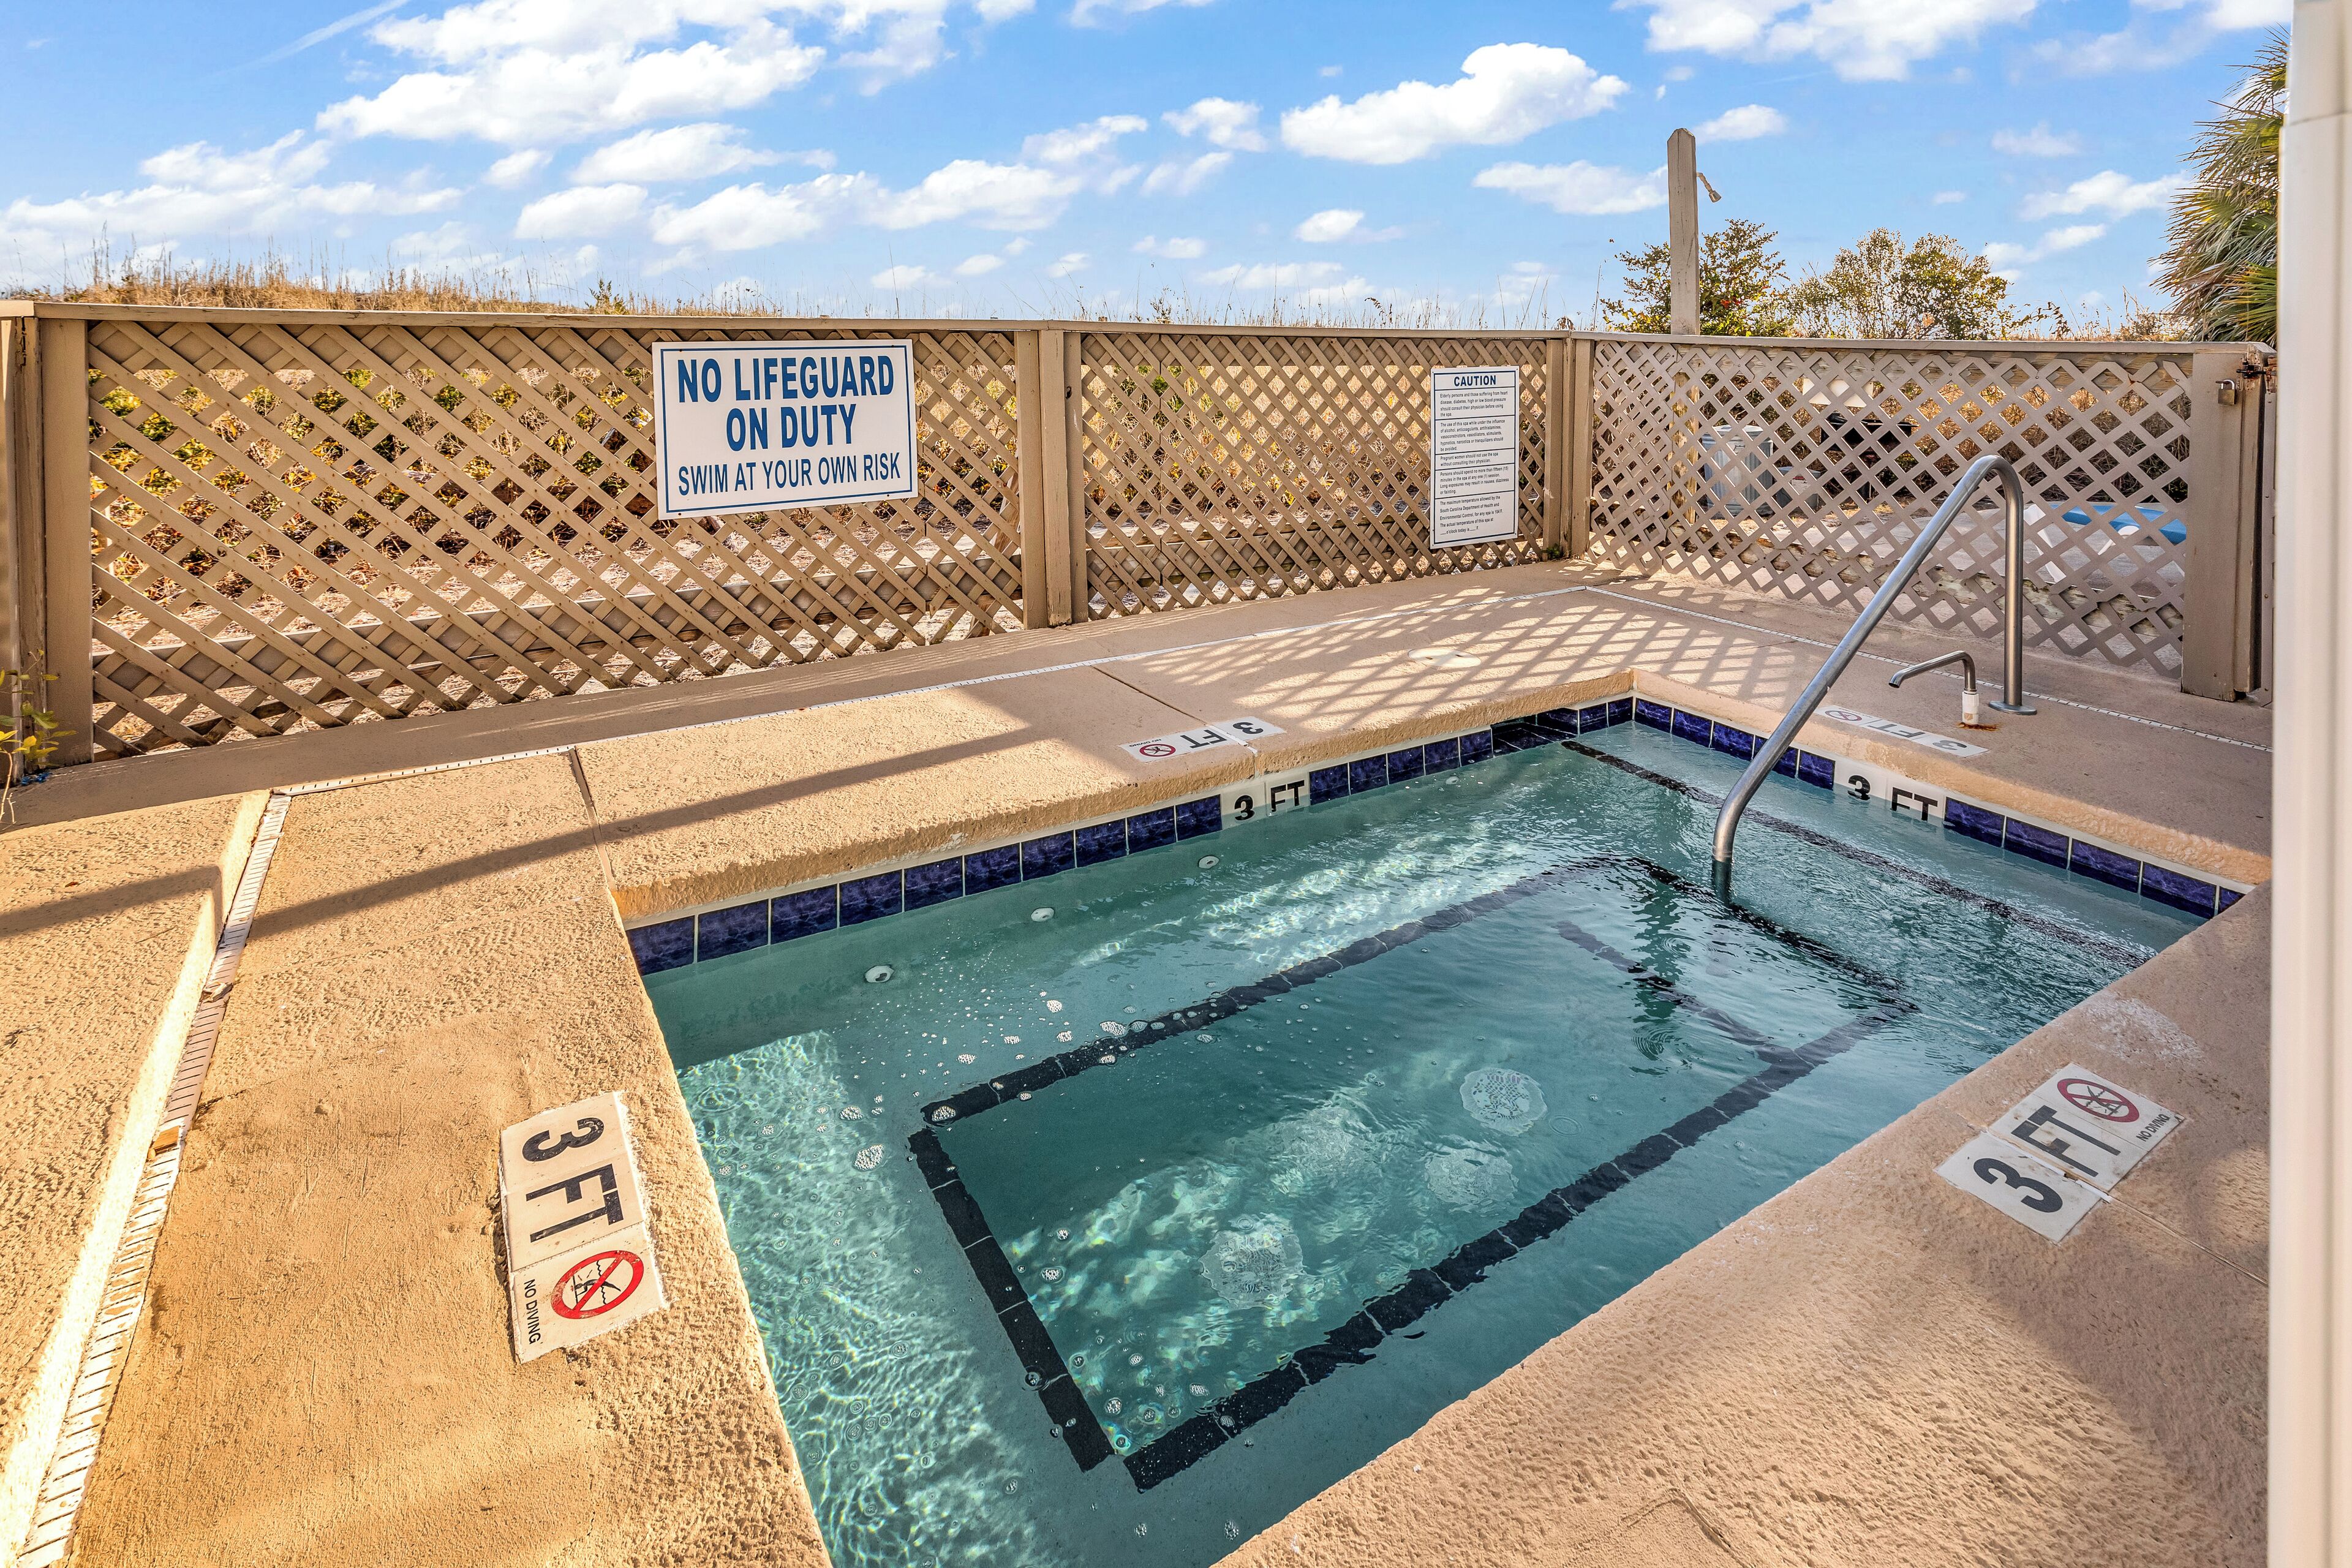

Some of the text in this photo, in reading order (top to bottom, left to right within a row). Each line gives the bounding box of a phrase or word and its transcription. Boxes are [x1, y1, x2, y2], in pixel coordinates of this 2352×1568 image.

[677, 355, 894, 403] NO LIFEGUARD
[1454, 375, 1496, 386] CAUTION
[726, 404, 856, 452] ON DUTY
[679, 452, 901, 496] SWIM AT YOUR OWN RISK
[1180, 722, 1264, 749] 3 FT
[1868, 723, 1967, 751] 3 FT
[1234, 780, 1305, 821] 3 FT
[1847, 775, 1938, 821] 3 FT
[2136, 1114, 2171, 1142] NO DIVING
[522, 1117, 624, 1243] 3 FT
[1973, 1105, 2121, 1213] 3 FT
[524, 1278, 541, 1344] NO DIVING
